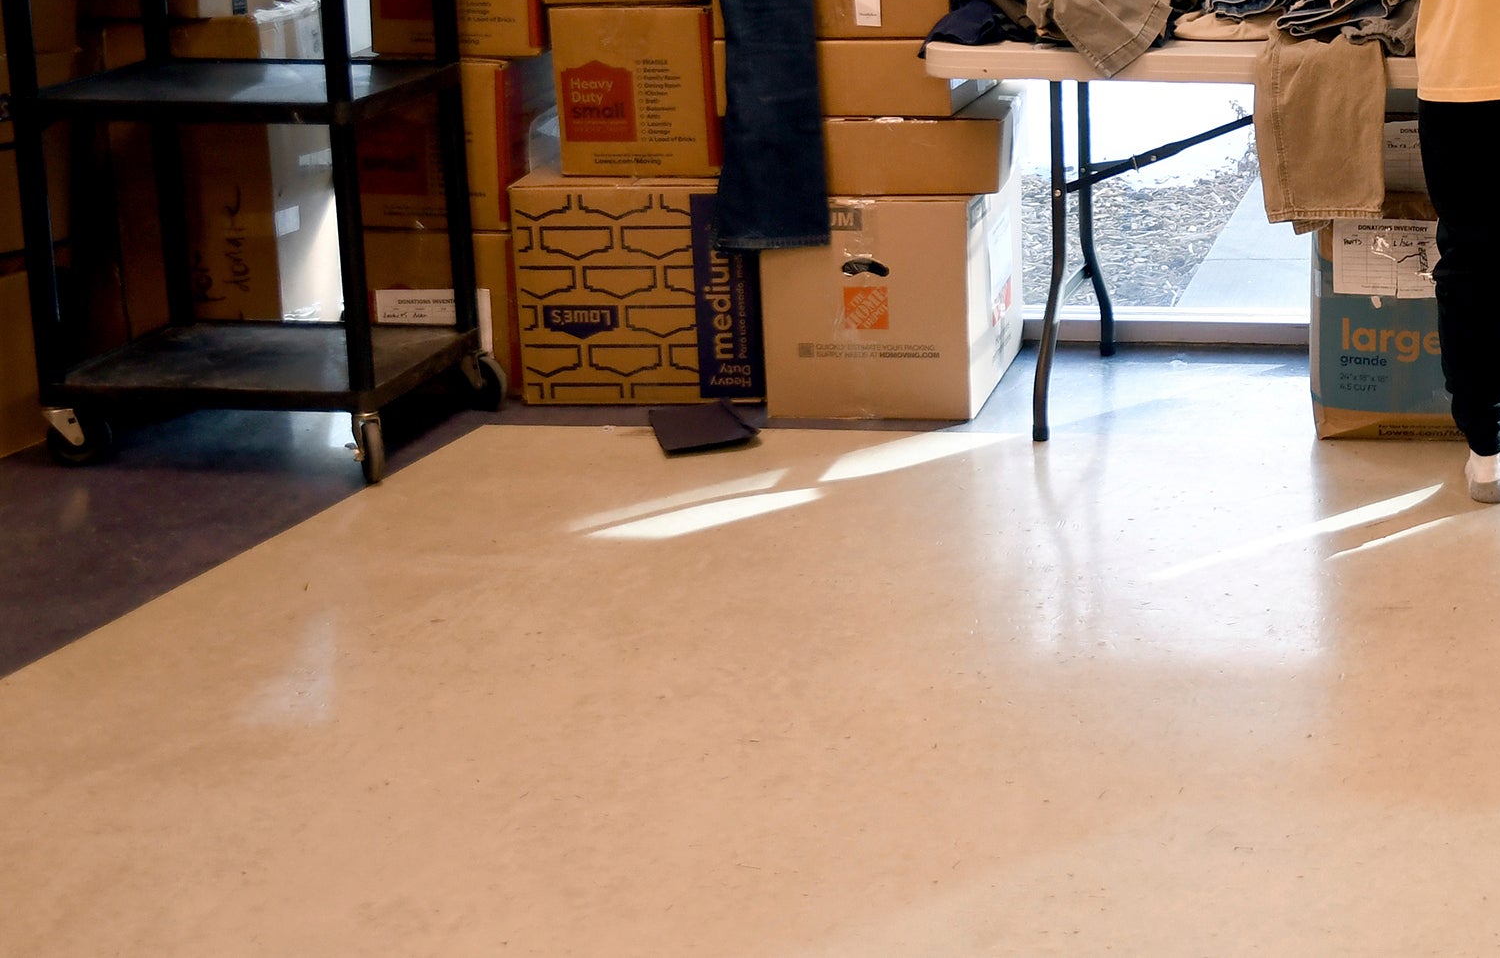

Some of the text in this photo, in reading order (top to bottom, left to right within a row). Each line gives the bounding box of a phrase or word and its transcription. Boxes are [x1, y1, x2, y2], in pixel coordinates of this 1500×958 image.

[570, 78, 613, 92] Heavy
[571, 91, 603, 105] Duty
[572, 102, 625, 120] small
[1358, 224, 1393, 232] DONATIONS
[551, 309, 611, 326] LOWE'S
[739, 319, 747, 336] uso
[1341, 317, 1441, 364] large
[739, 337, 748, 359] Para
[1340, 355, 1388, 367] grande
[719, 362, 752, 375] Duty
[710, 375, 752, 388] Heavy
